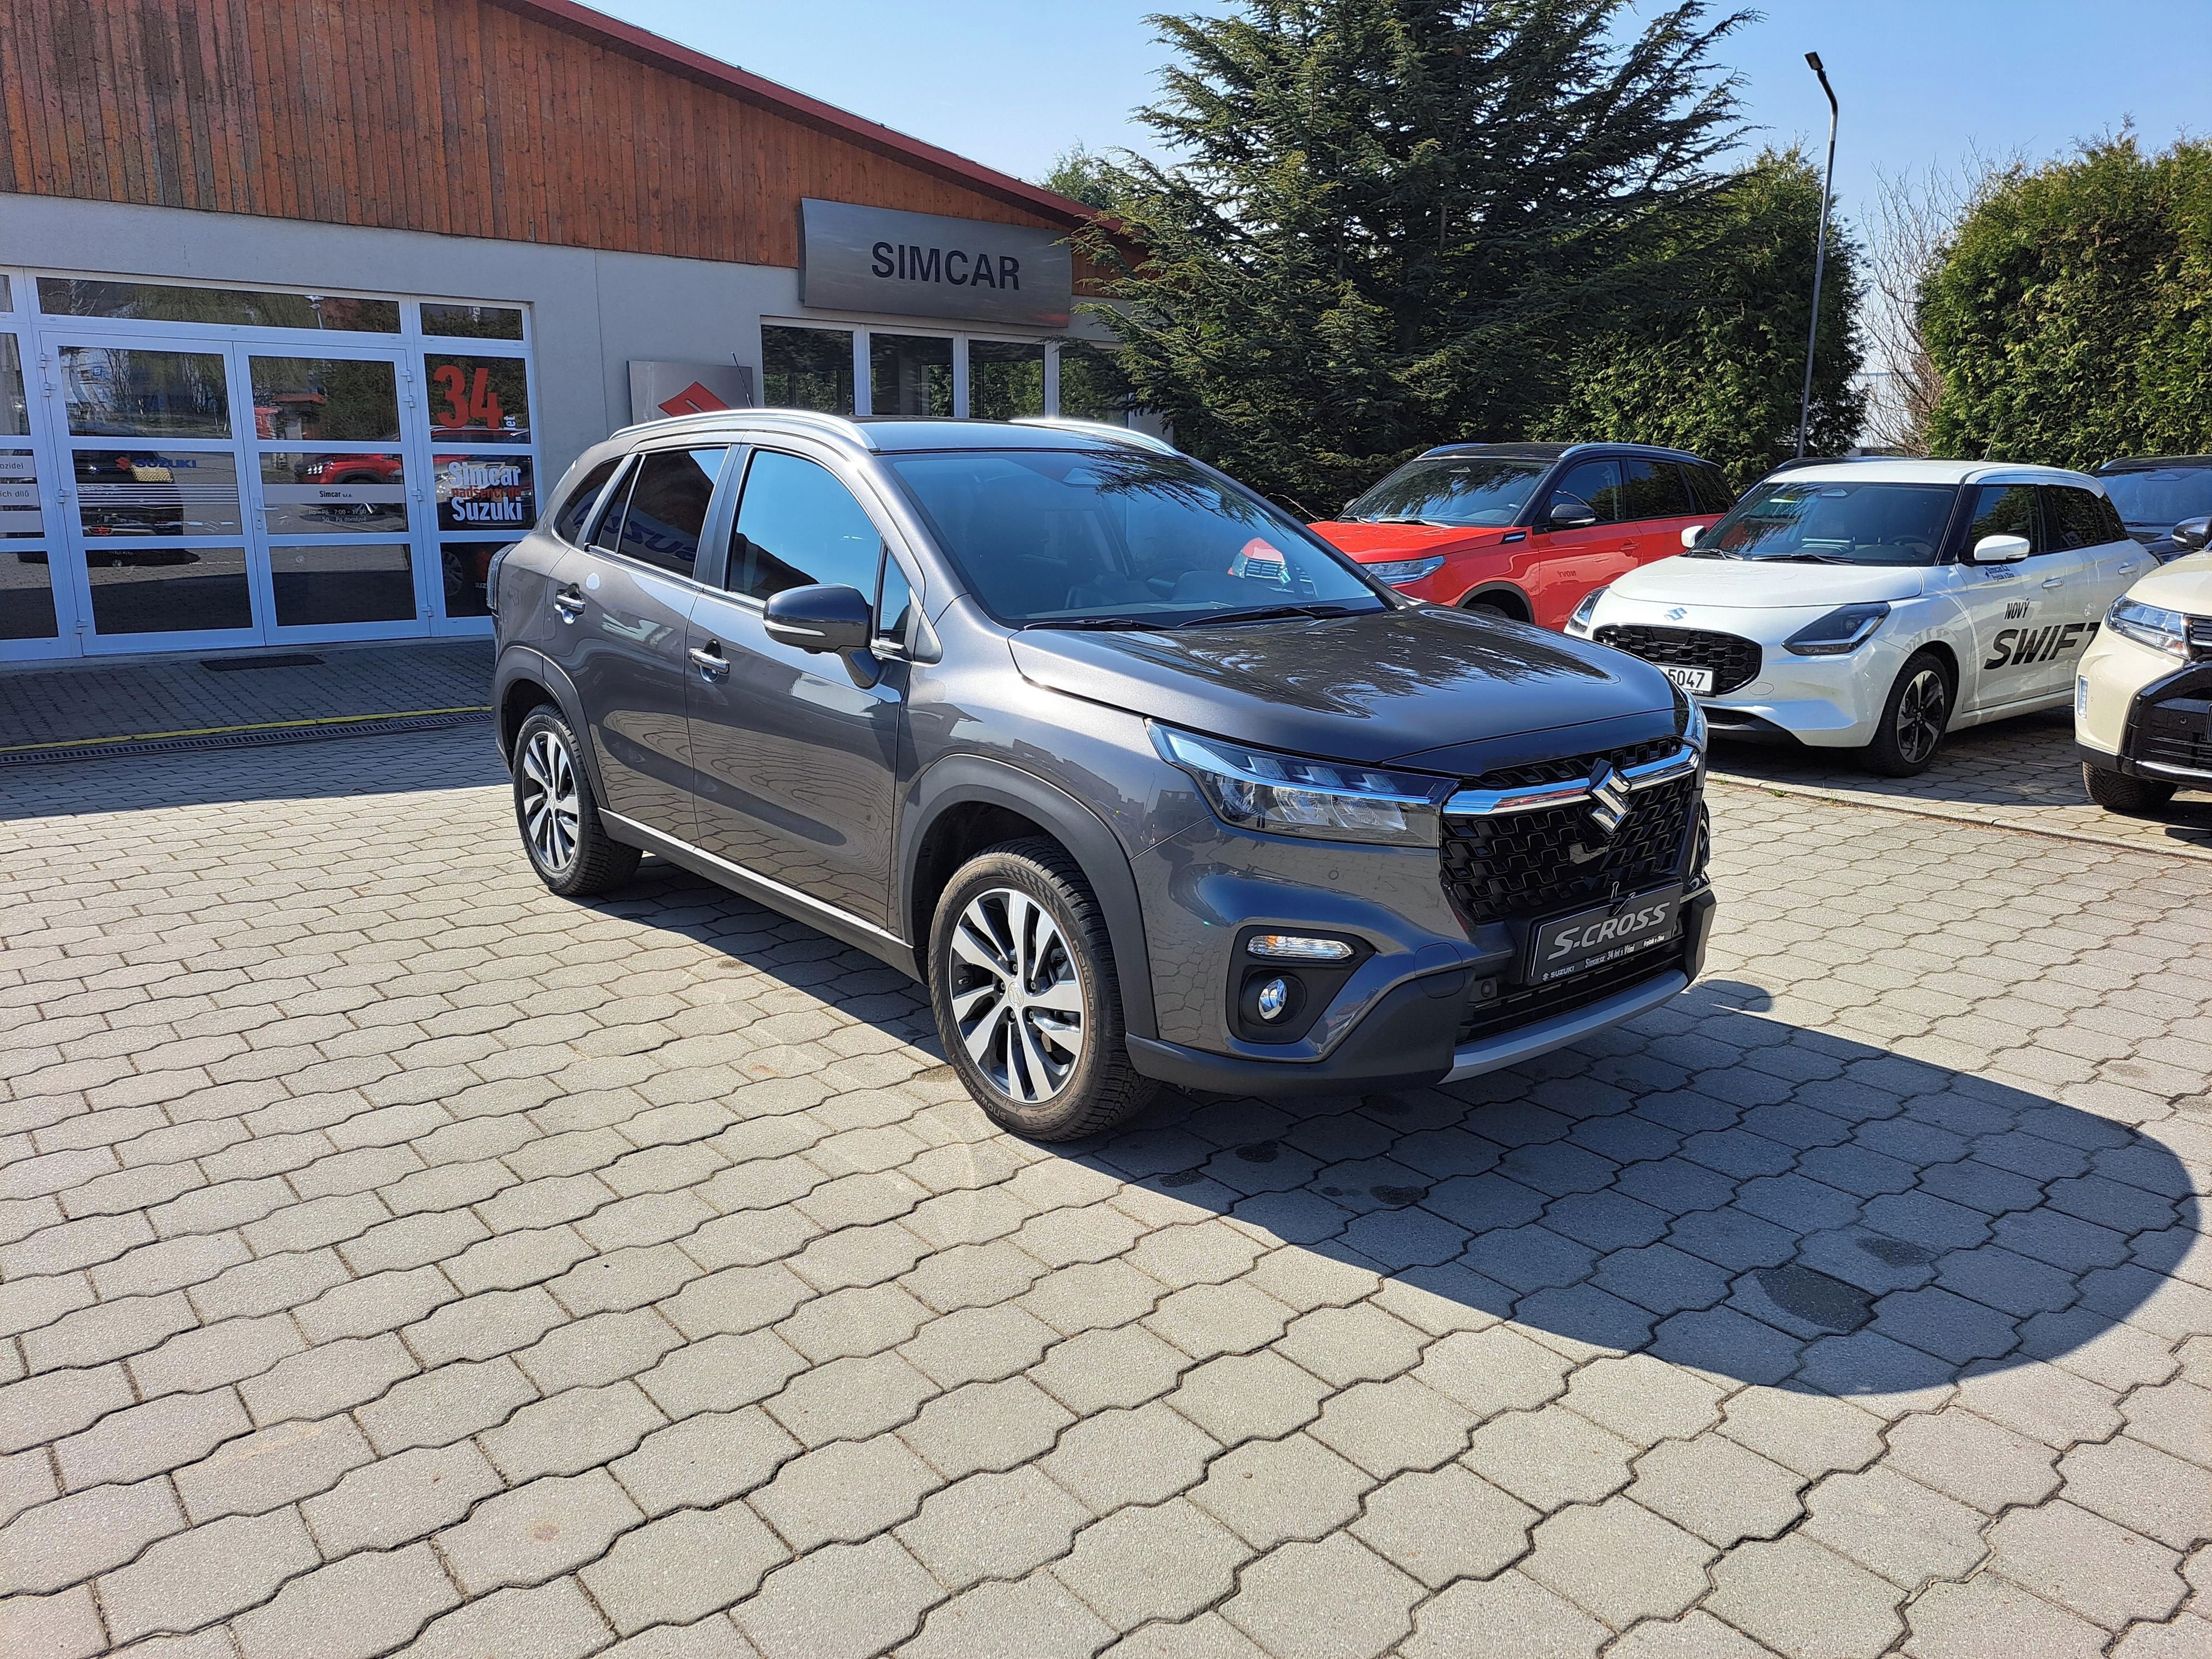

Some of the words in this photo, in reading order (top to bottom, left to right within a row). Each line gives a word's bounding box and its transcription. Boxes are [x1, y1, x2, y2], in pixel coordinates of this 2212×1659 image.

[872, 241, 1020, 290] SIMCAR
[434, 365, 503, 429] 34
[134, 459, 197, 468] SUZUKI
[448, 462, 521, 486] Simcar
[451, 497, 523, 521] Suzuki
[2004, 598, 2030, 619] NOVÝ
[1547, 902, 1670, 961] S-CROSS
[1550, 965, 1575, 977] SUZUKI
[1607, 950, 1614, 960] 34
